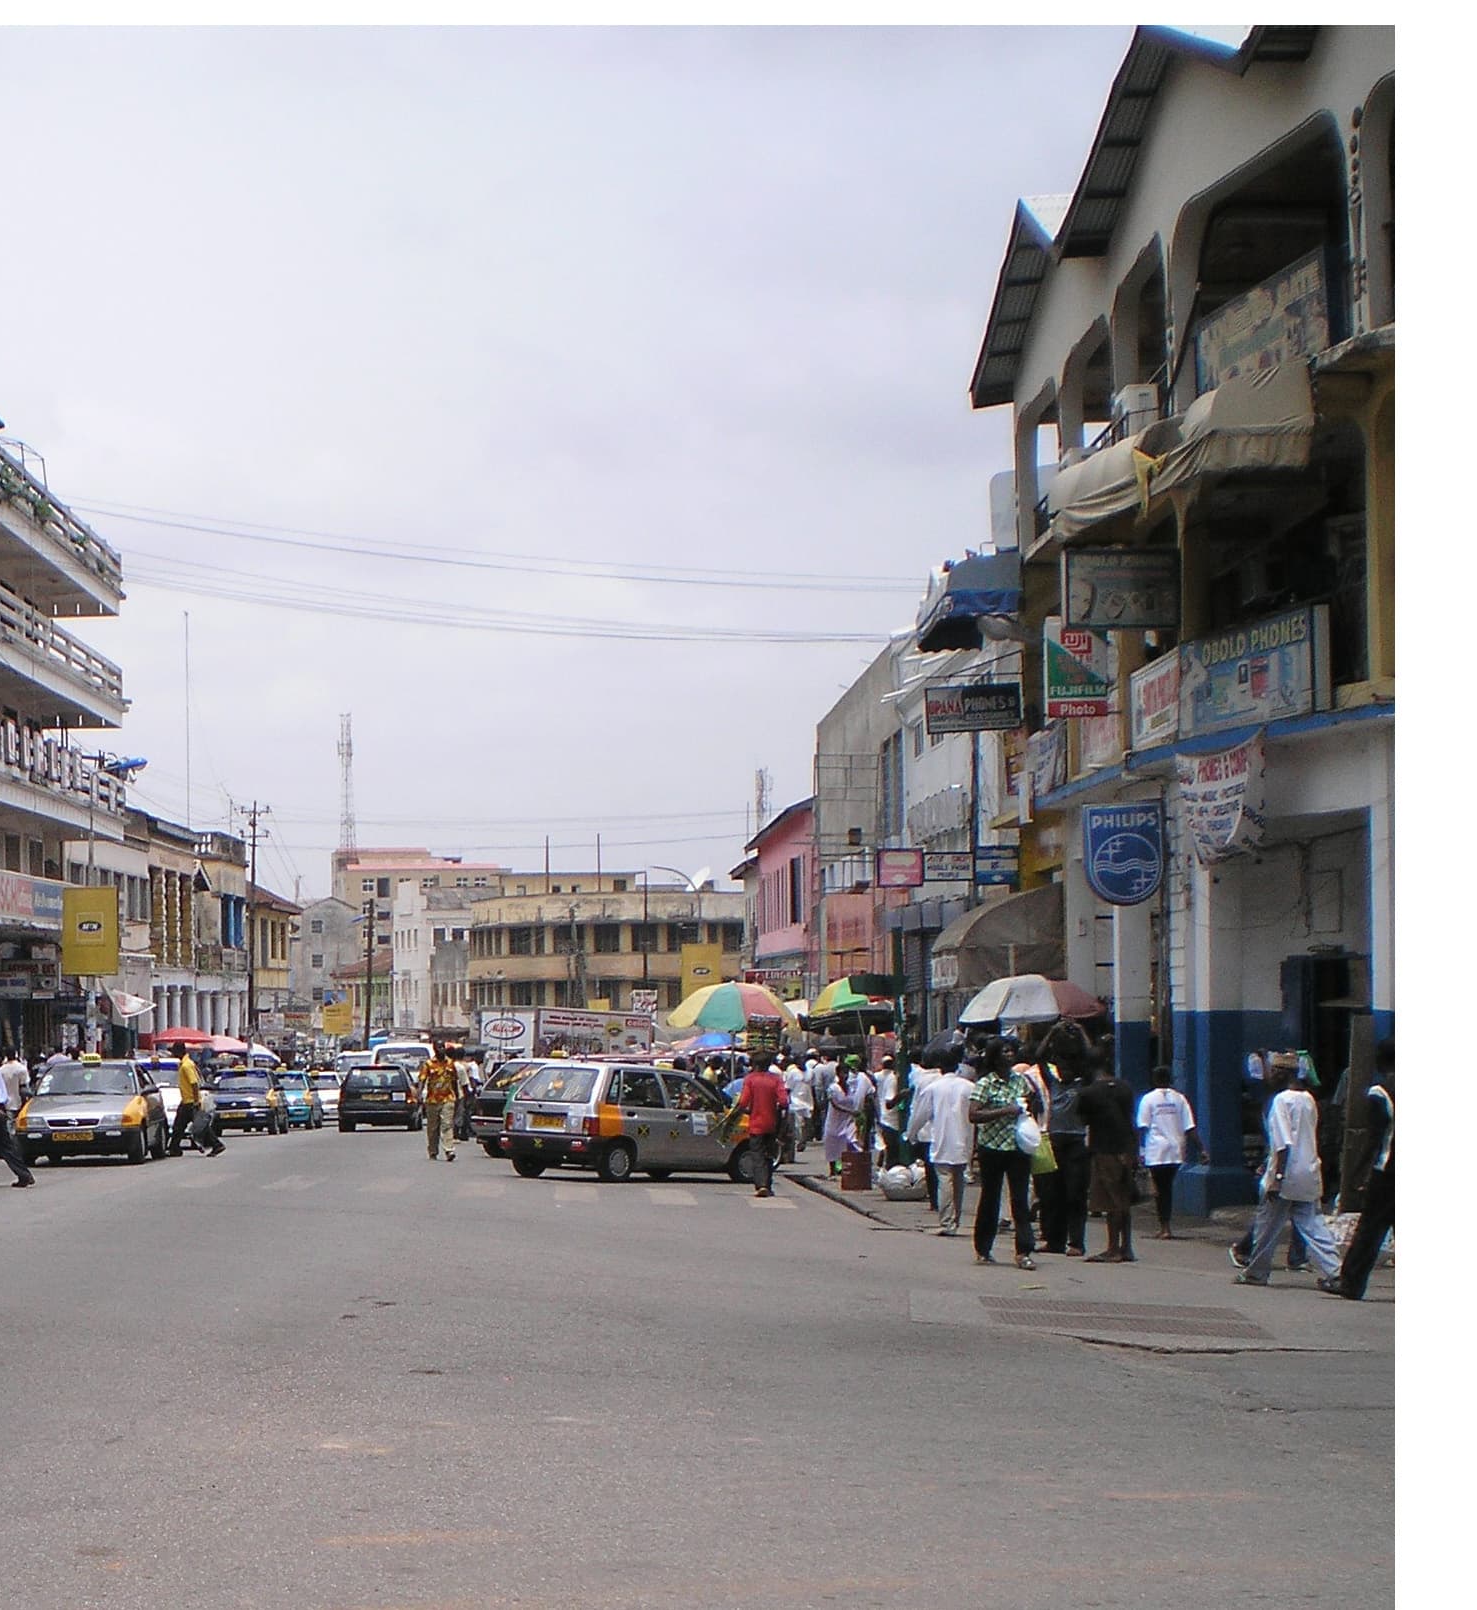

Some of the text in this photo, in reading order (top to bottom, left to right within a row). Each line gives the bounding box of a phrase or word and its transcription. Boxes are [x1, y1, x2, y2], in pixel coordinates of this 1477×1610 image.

[1202, 615, 1307, 667] OBOLO PHONES
[1050, 686, 1106, 696] FUJIFILM
[1060, 703, 1096, 715] Photo
[1091, 812, 1157, 830] PHILIPS
